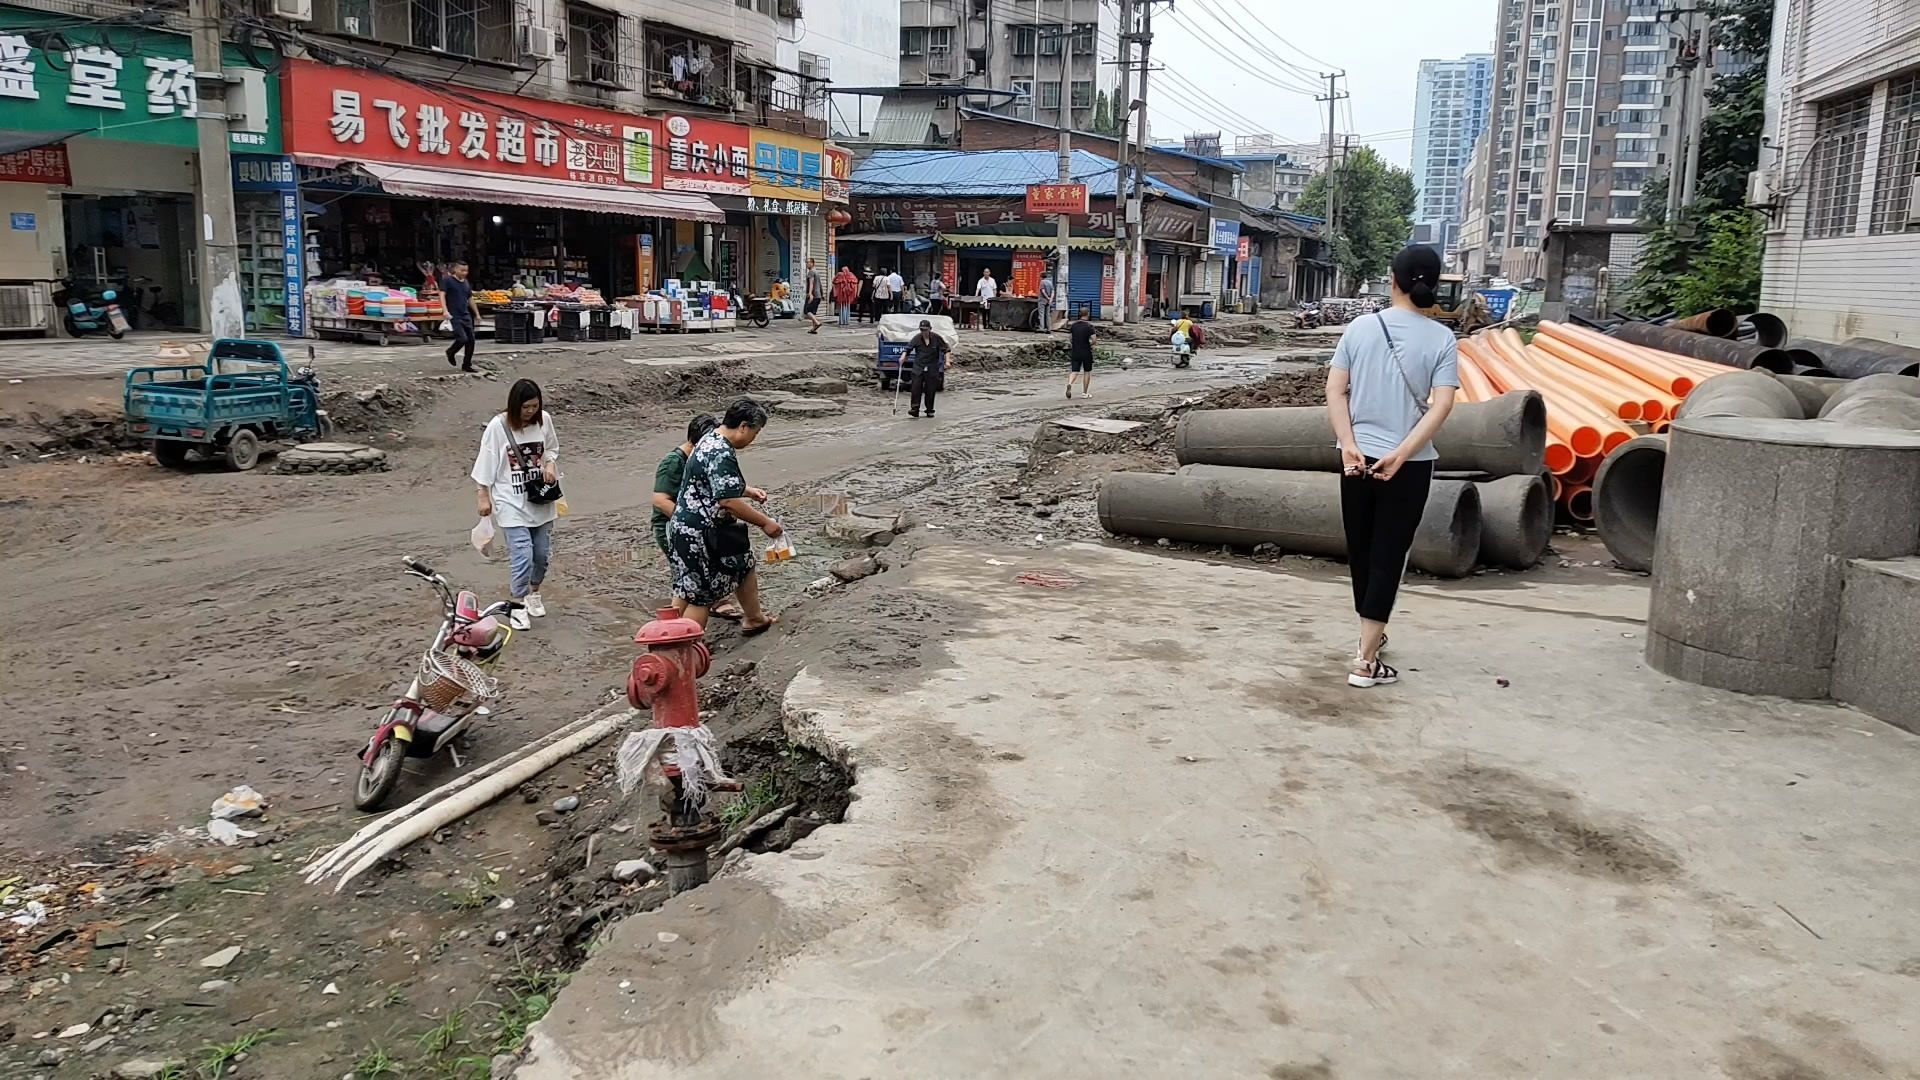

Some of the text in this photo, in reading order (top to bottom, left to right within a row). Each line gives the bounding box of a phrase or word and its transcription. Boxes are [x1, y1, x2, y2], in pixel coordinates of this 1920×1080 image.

[328, 89, 560, 167] 易飞批发超市
[238, 161, 293, 183] 婴幼儿用品
[669, 137, 748, 179] 重庆小面
